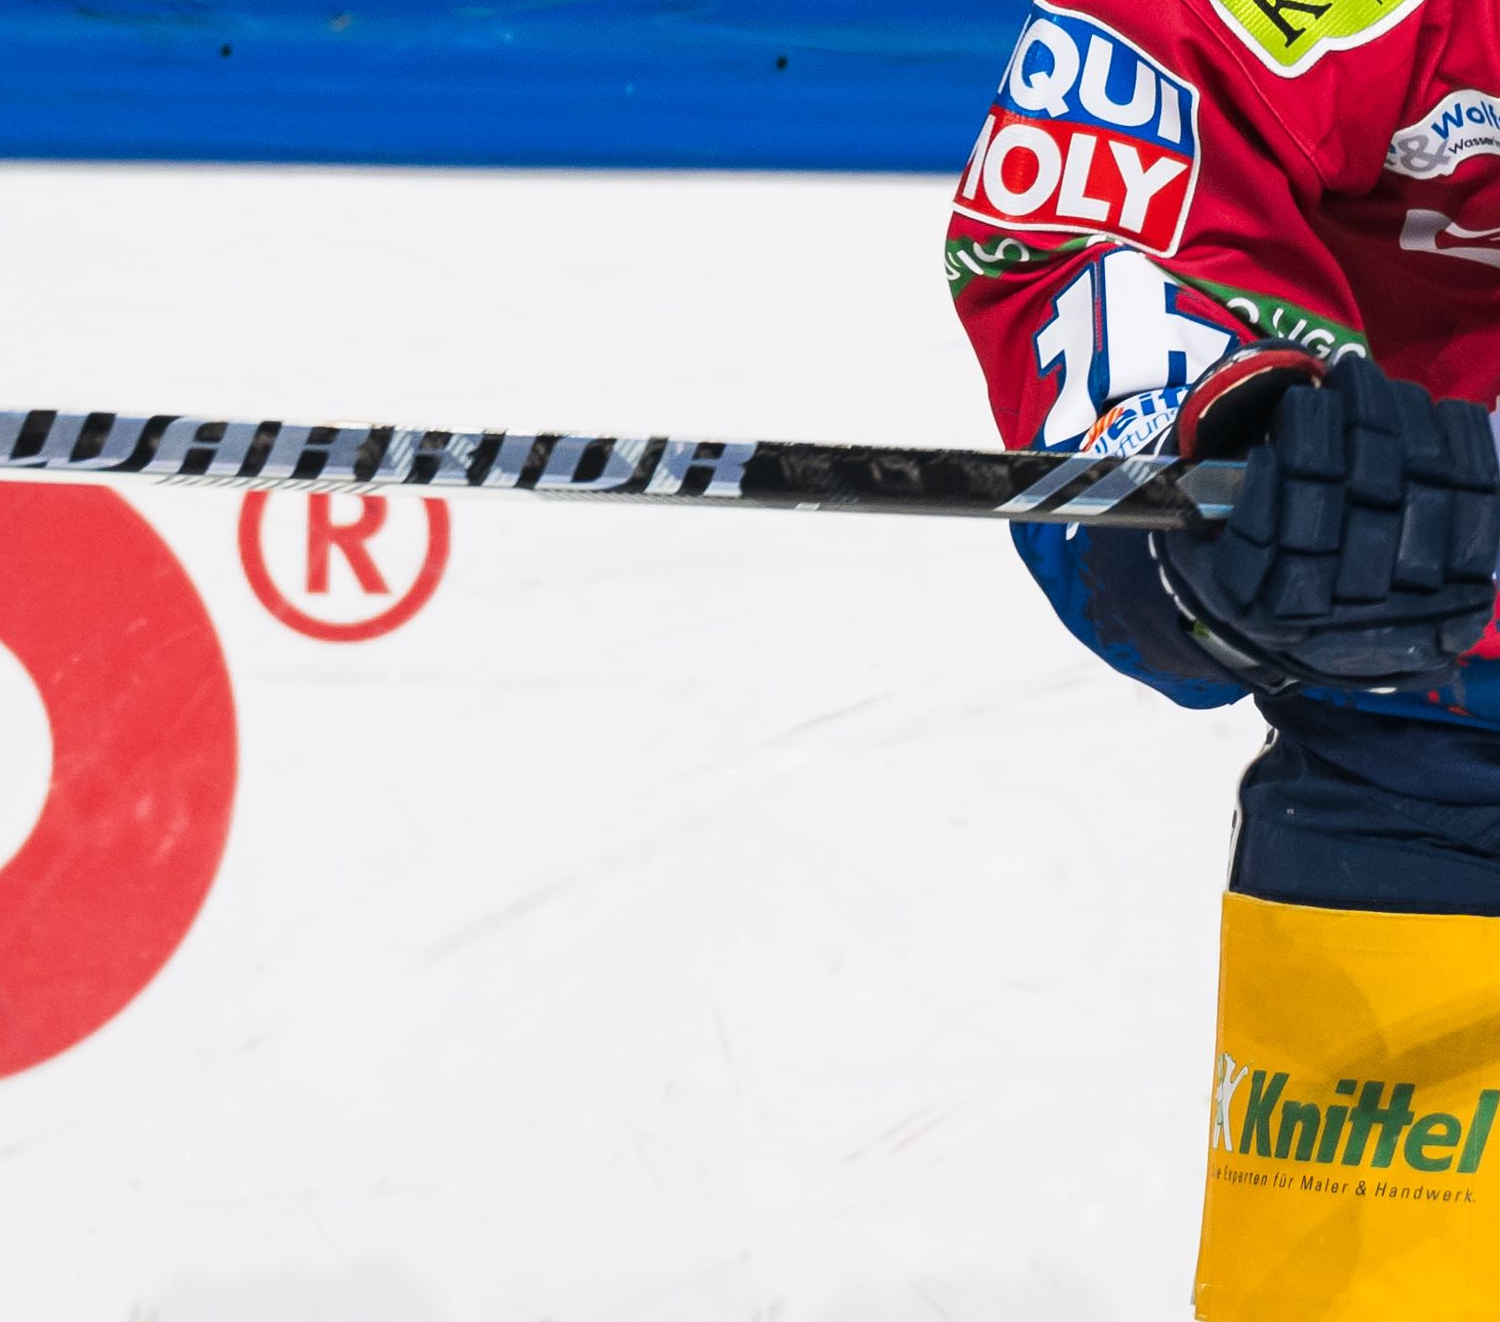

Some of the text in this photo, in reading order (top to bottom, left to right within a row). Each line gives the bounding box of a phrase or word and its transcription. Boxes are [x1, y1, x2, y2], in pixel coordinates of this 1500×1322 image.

[1008, 17, 1182, 145] QUI
[1223, 1165, 1268, 1187] Experten
[1273, 1171, 1295, 1189] für
[1300, 1175, 1349, 1195] Maler
[1355, 1180, 1367, 1197] &
